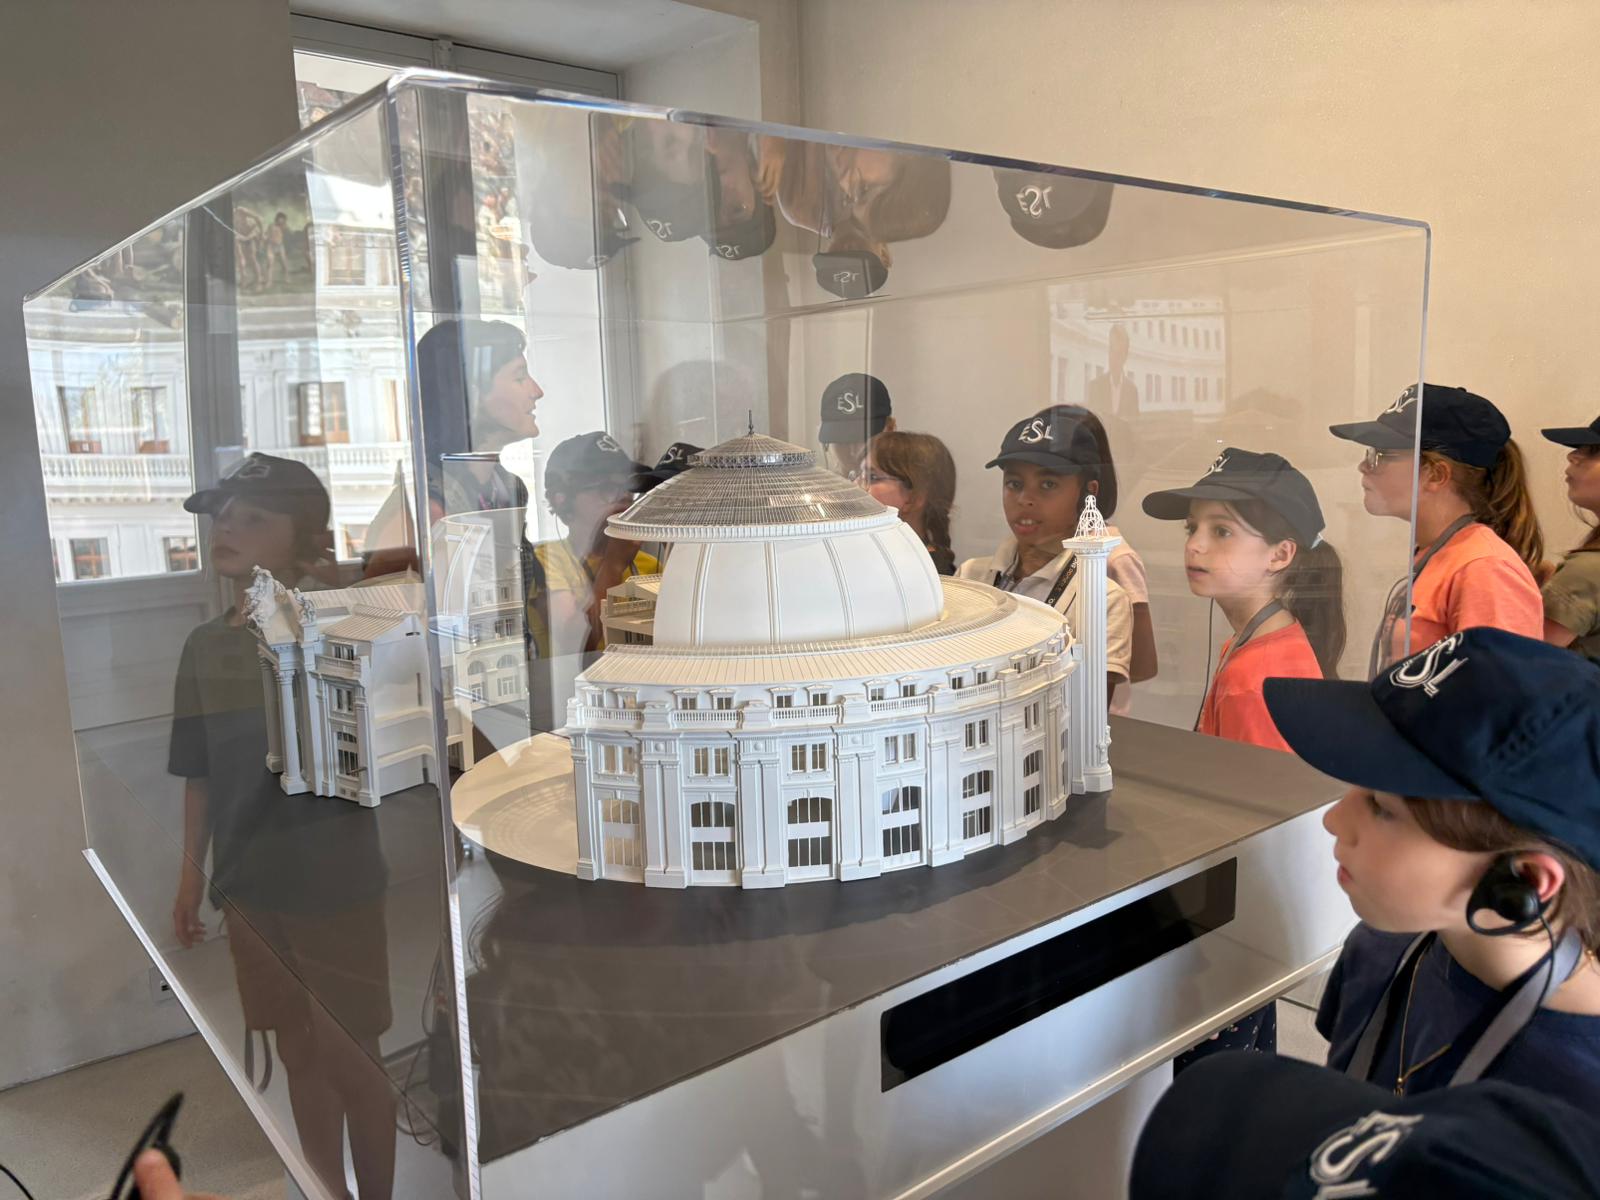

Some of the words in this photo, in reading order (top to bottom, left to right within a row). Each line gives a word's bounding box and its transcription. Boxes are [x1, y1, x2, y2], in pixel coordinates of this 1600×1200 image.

[837, 392, 864, 415] ESL
[1018, 417, 1054, 444] ESL
[1389, 631, 1469, 698] SL
